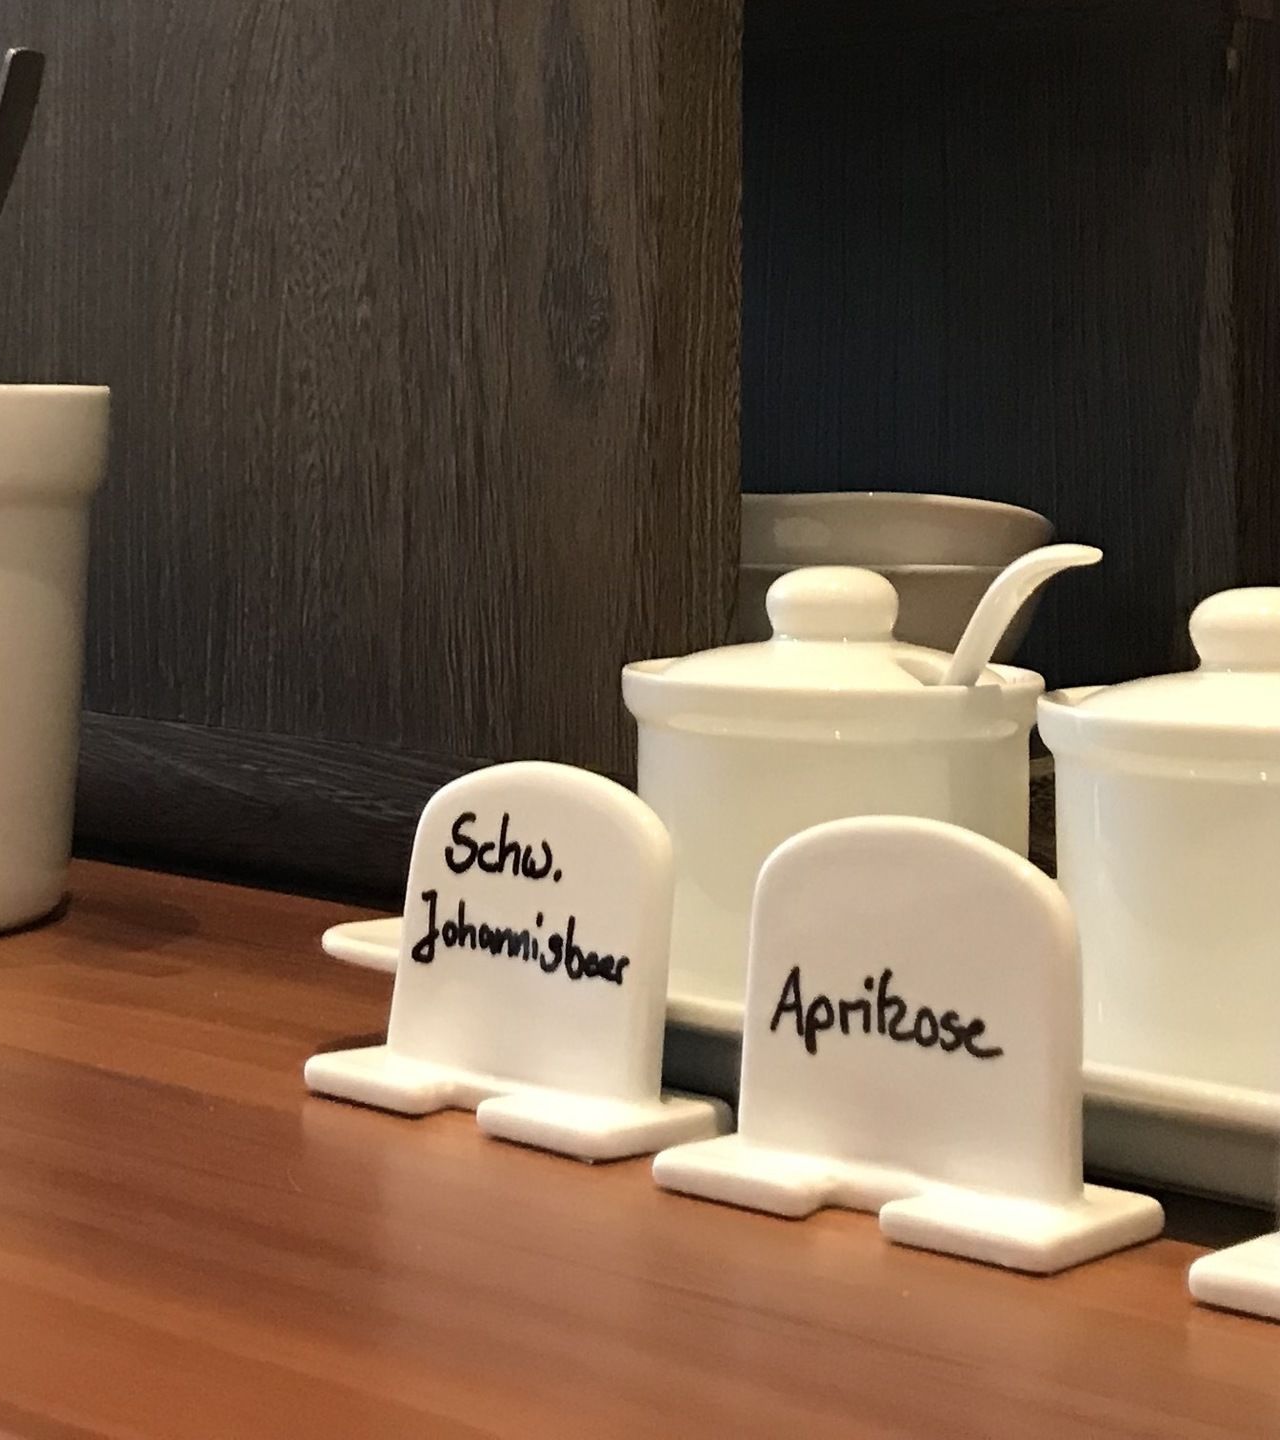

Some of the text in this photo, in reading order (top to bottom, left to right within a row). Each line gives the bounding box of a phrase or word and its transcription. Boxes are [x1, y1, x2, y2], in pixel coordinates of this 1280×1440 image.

[444, 811, 563, 883] Schw.
[411, 888, 631, 986] Johannisbeer
[770, 965, 1004, 1059] Aprikose
